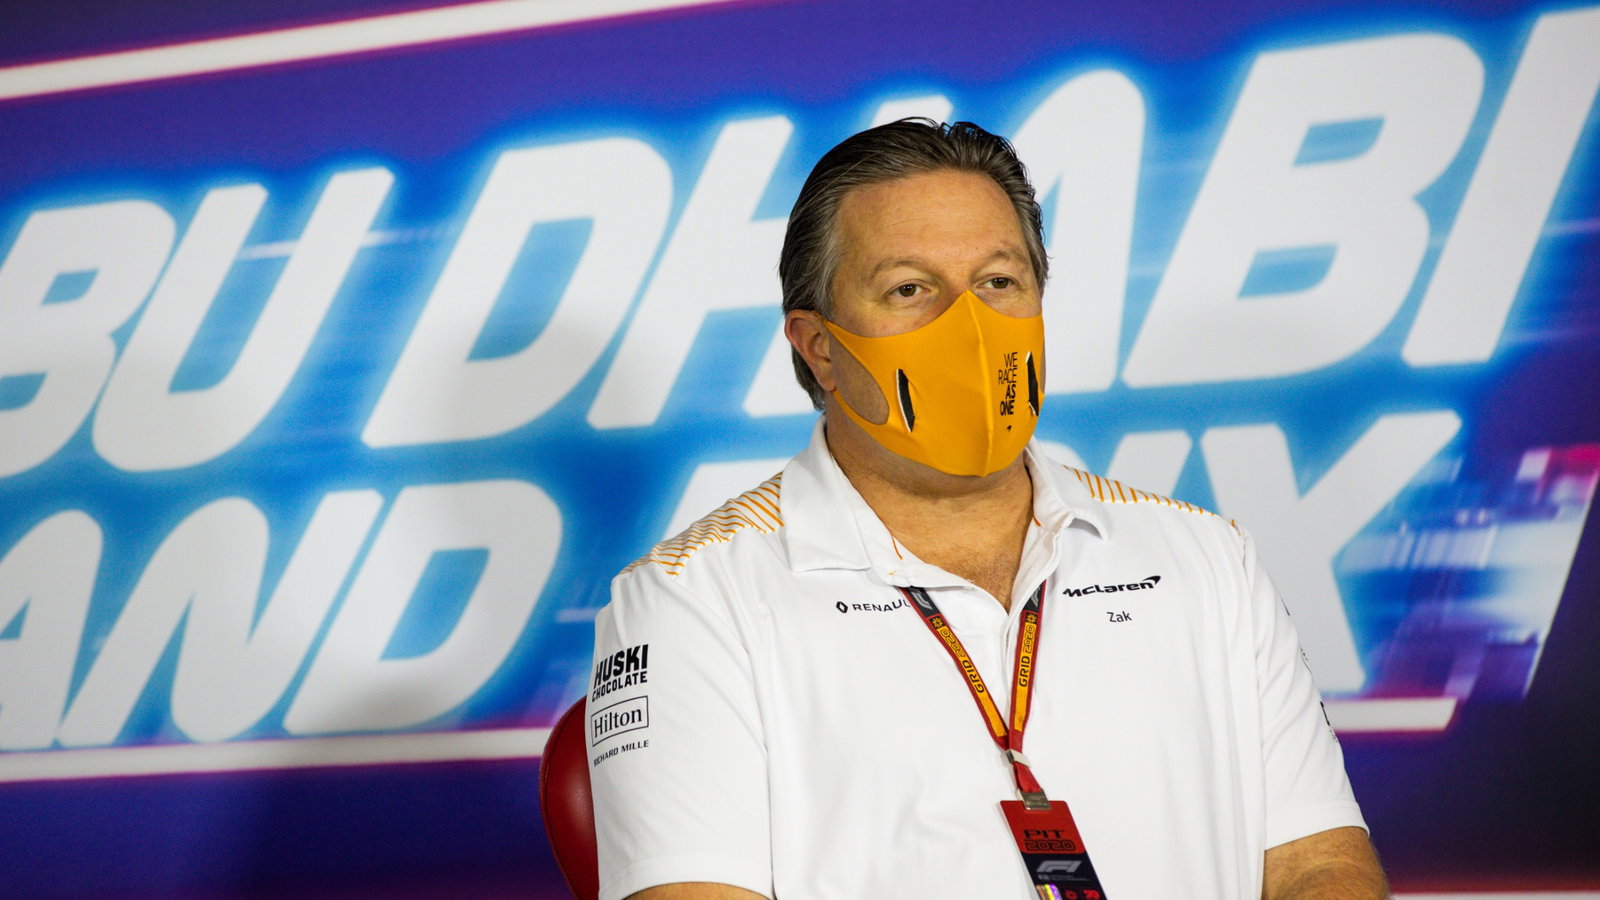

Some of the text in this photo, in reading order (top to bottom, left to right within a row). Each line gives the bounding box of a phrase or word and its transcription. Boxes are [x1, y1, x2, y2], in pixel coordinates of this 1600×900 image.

[1003, 352, 1018, 368] WE
[998, 368, 1018, 385] RACE
[1005, 384, 1016, 400] AS
[1000, 400, 1015, 416] ONE
[1062, 576, 1160, 597] McLaren
[852, 599, 911, 612] RENAUL
[1106, 610, 1133, 623] Zak
[940, 628, 985, 694] GRID 2020
[1018, 624, 1035, 688] GRID 2020
[593, 644, 649, 689] HUSKI
[591, 671, 648, 702] CHOCOLATE
[594, 708, 642, 738] Hilton
[593, 740, 649, 767] RICHARD MILLE
[1023, 829, 1065, 838] PIT
[1023, 839, 1077, 852] 2020
